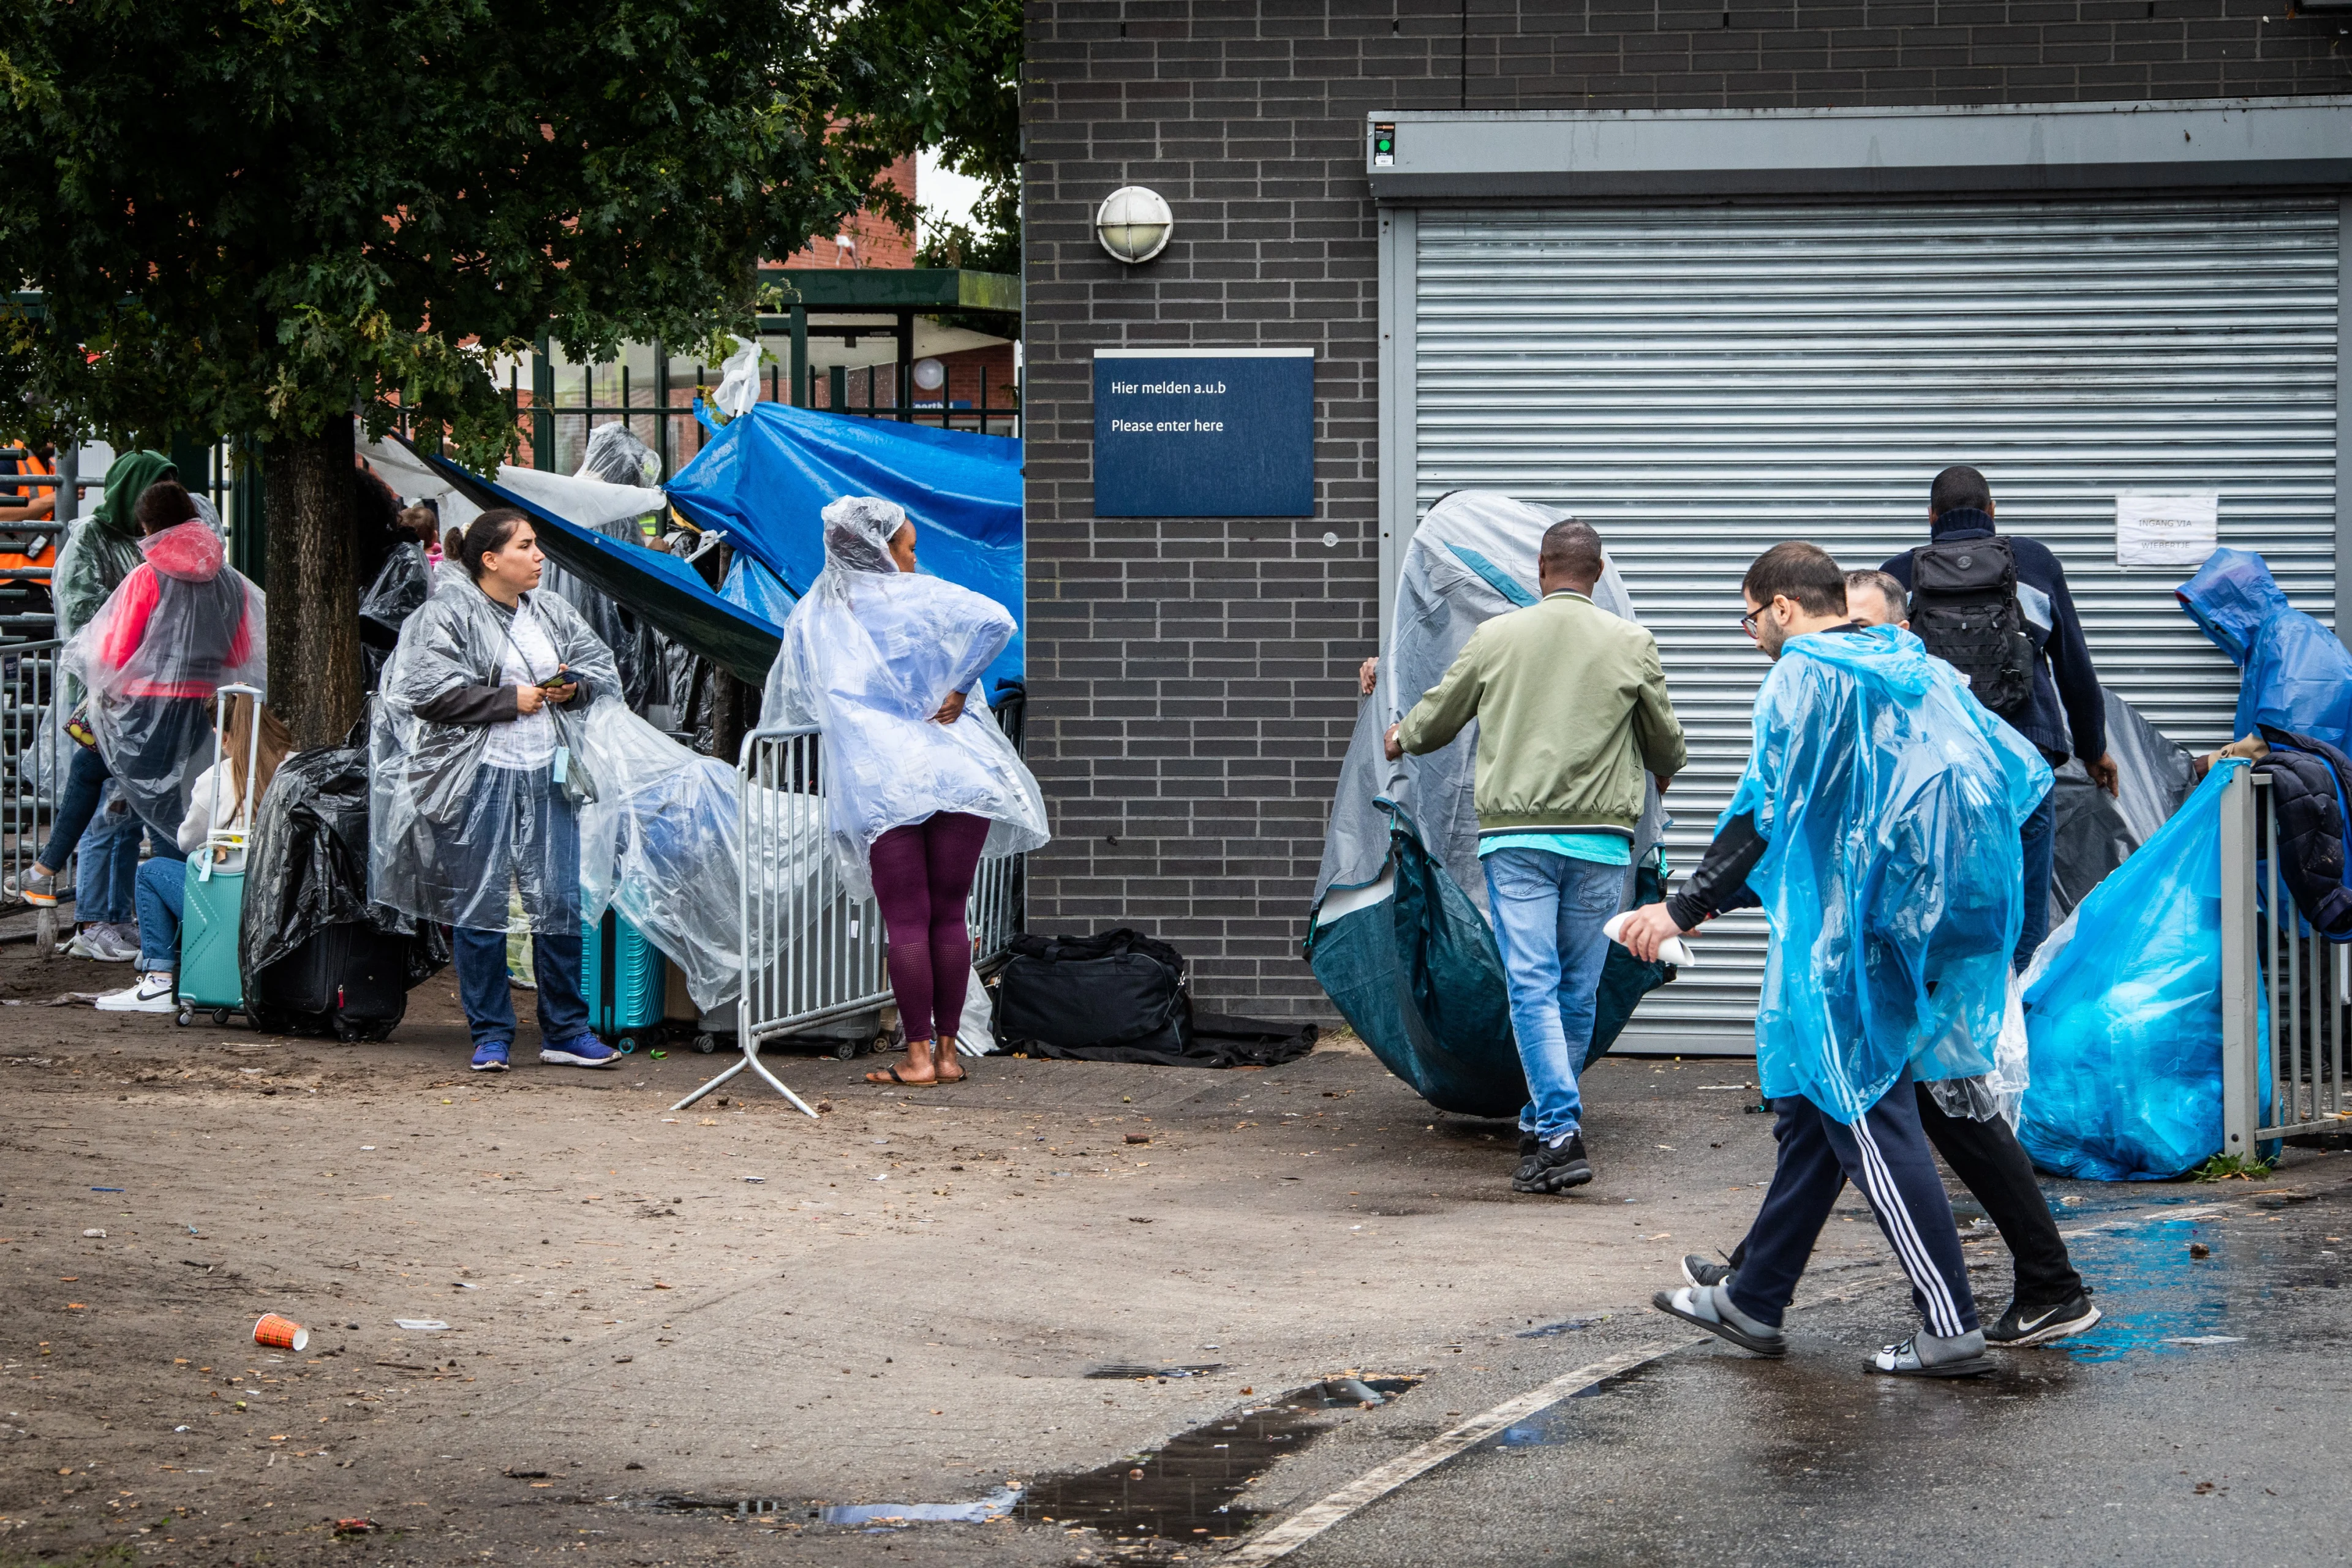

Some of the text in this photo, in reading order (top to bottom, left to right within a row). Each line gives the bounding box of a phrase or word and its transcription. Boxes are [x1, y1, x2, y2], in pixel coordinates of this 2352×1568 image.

[1112, 381, 1226, 394] Hier melden a.u.b
[1112, 418, 1224, 432] Please enter here
